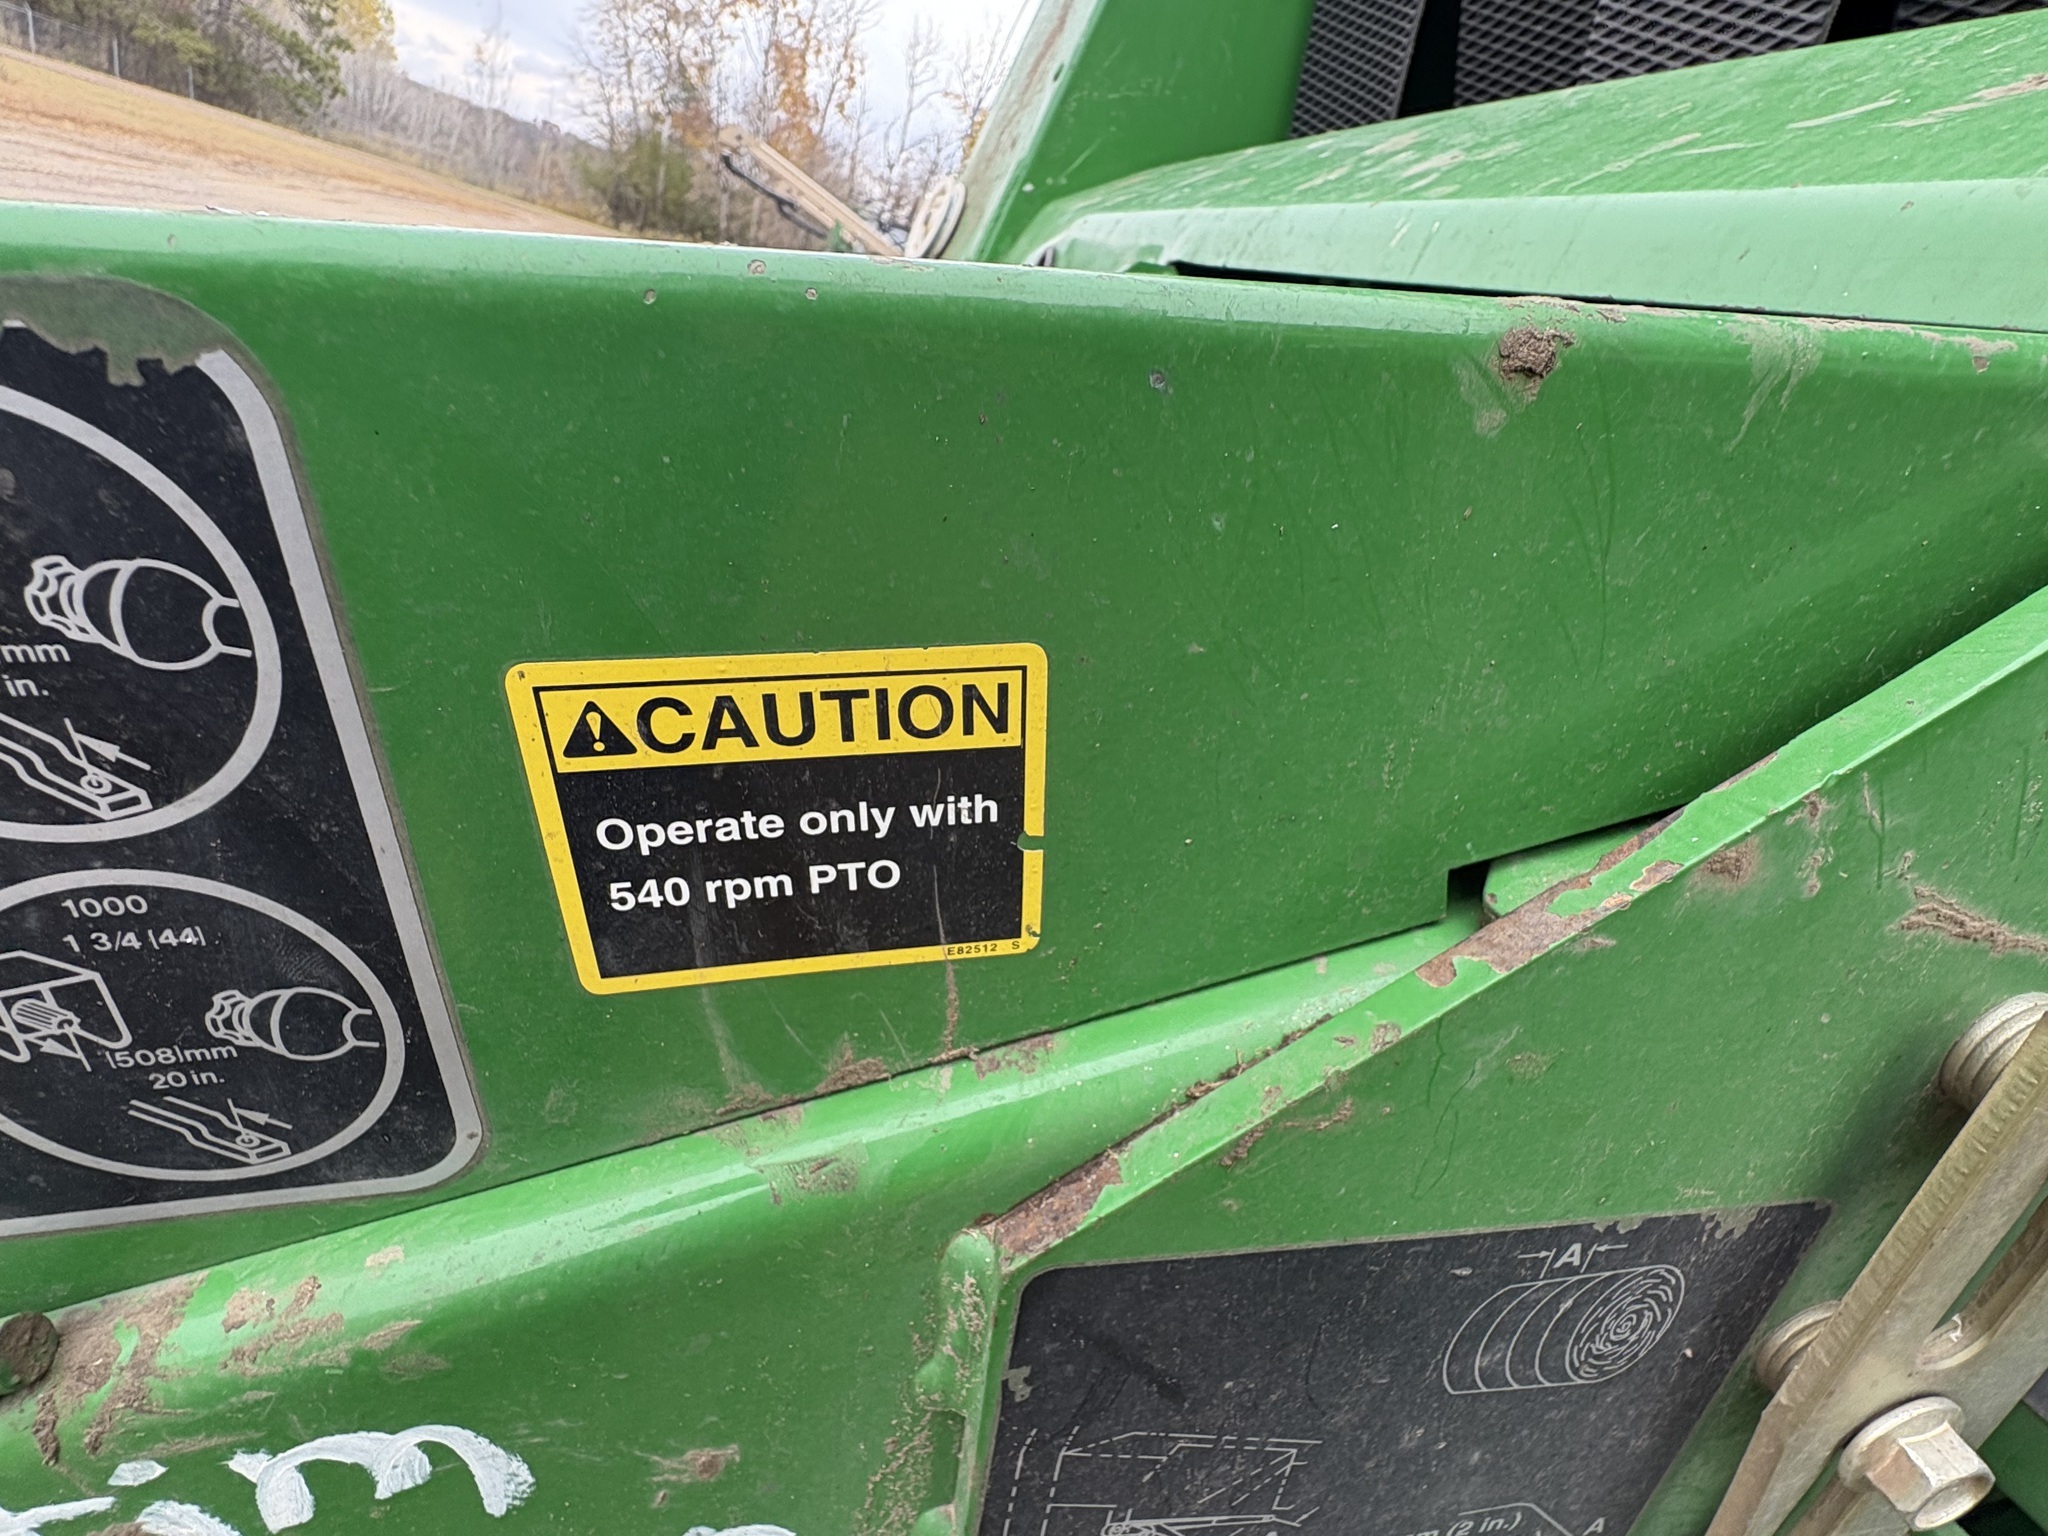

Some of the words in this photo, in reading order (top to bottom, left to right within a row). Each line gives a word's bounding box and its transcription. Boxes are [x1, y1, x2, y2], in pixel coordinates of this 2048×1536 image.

[1, 674, 50, 697] in.
[636, 681, 1010, 755] CAUTION
[595, 809, 786, 855] Operate
[799, 802, 896, 839] only
[909, 794, 999, 828] with
[608, 876, 691, 912] 540
[705, 869, 794, 908] rpm
[809, 859, 901, 894] PTO
[60, 894, 149, 919] 1000
[62, 934, 80, 953] 1
[90, 930, 143, 952] 3/4
[947, 943, 998, 956] E82512
[1011, 940, 1020, 950] S
[148, 1070, 188, 1090] 20
[189, 1069, 226, 1086] in.
[1552, 1242, 1583, 1269] A
[1477, 1511, 1522, 1534] in.)
[1582, 1516, 1606, 1536] A
